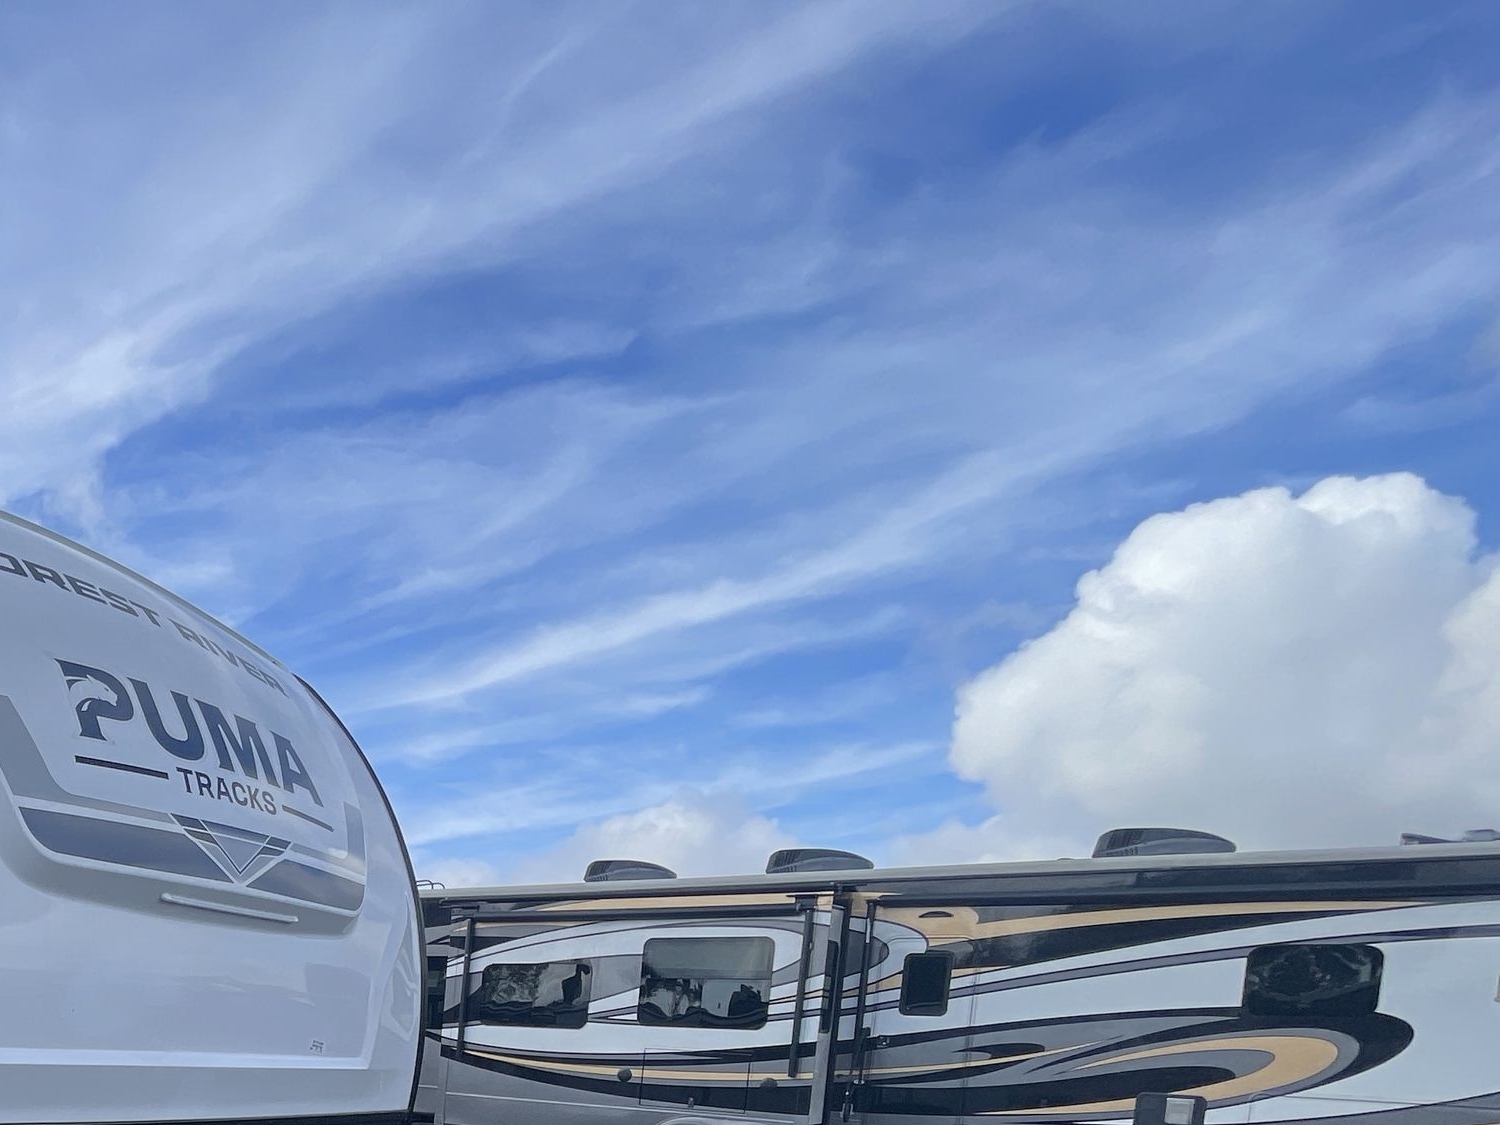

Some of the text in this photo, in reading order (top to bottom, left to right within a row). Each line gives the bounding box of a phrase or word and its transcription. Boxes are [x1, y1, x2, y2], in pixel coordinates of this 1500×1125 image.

[167, 616, 291, 699] RIVER
[54, 657, 325, 808] PUMA
[176, 766, 277, 816] TRACKS
